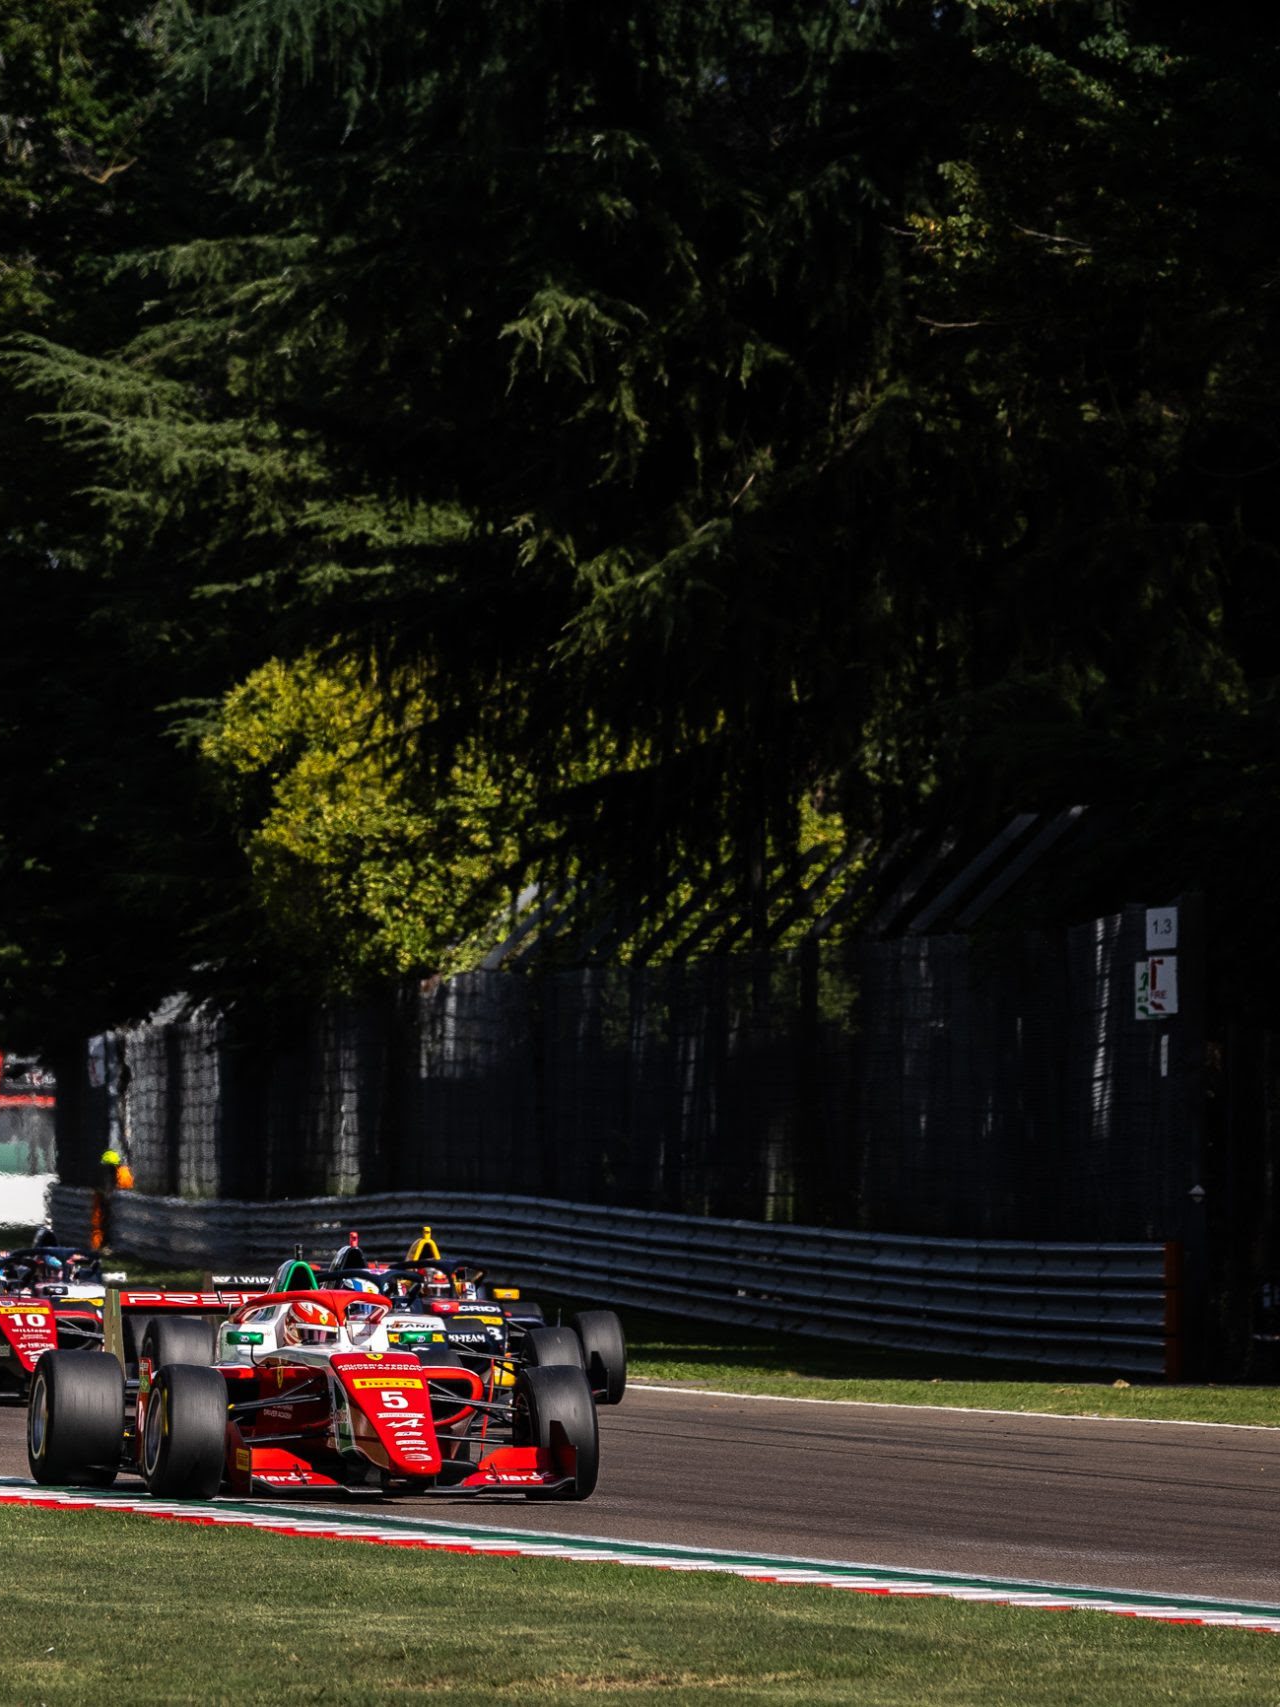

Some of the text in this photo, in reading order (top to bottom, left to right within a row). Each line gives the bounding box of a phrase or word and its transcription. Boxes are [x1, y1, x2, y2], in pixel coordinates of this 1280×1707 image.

[1152, 919, 1173, 934] 1.3
[7, 1313, 46, 1327] 10
[380, 1390, 409, 1409] 5
